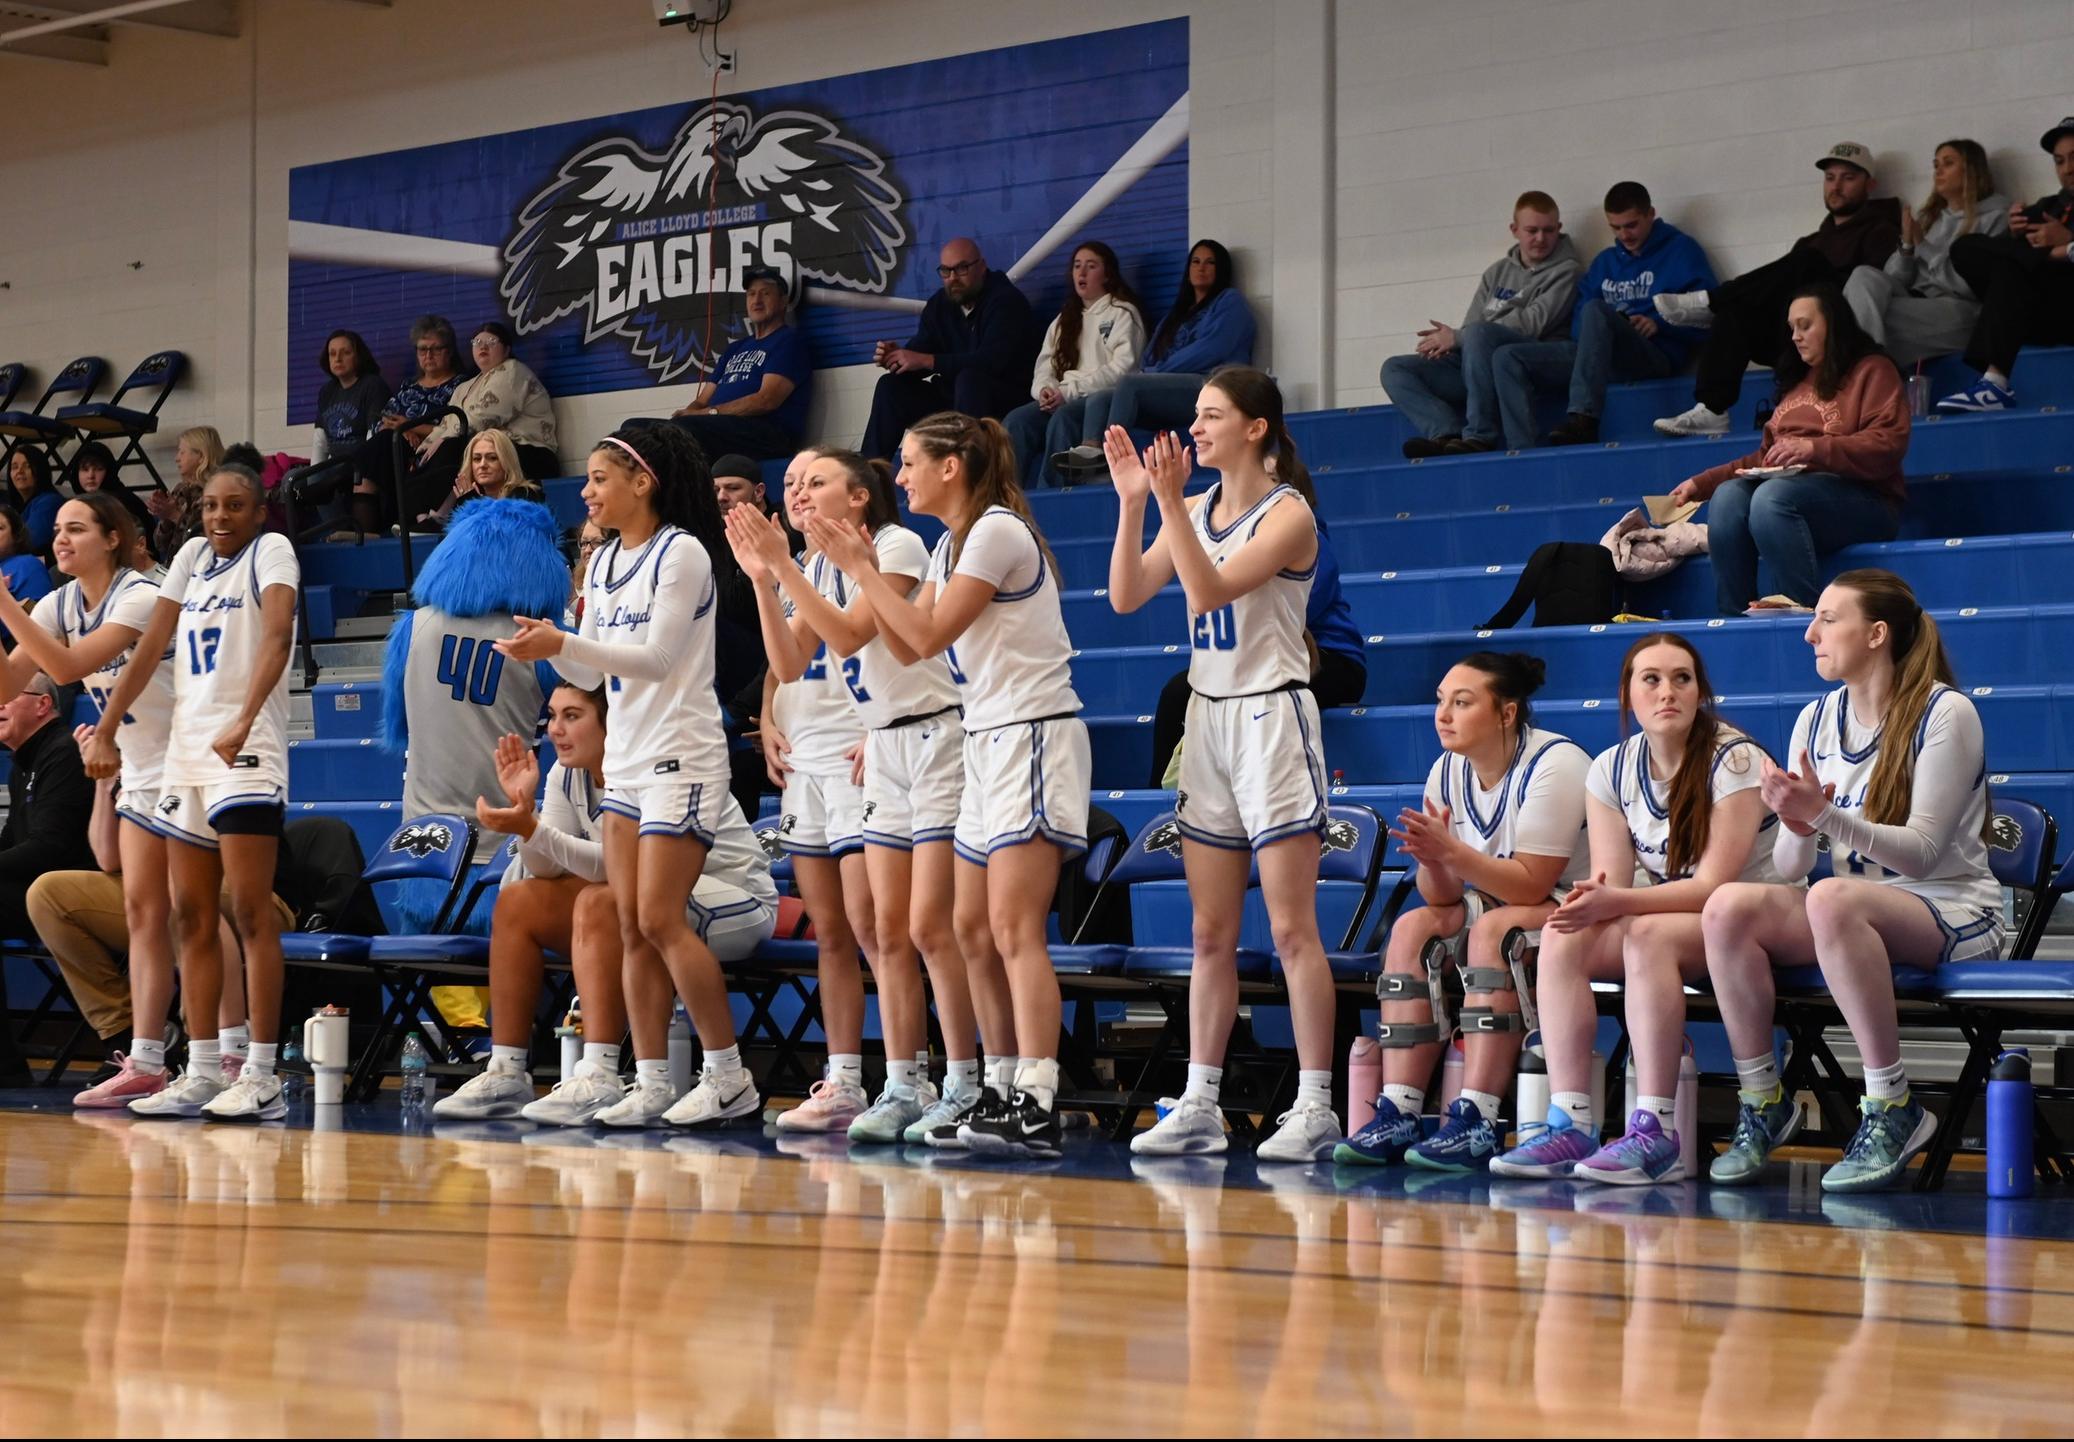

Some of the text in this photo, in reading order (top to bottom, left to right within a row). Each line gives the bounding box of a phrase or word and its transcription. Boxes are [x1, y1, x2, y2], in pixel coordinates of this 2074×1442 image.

[622, 205, 756, 239] ALICE LLOYD COLLEGE
[596, 221, 794, 325] EAGLES
[607, 602, 651, 632] Lloyd
[1193, 602, 1237, 651] 20
[188, 627, 222, 675] 12
[436, 633, 506, 707] 40
